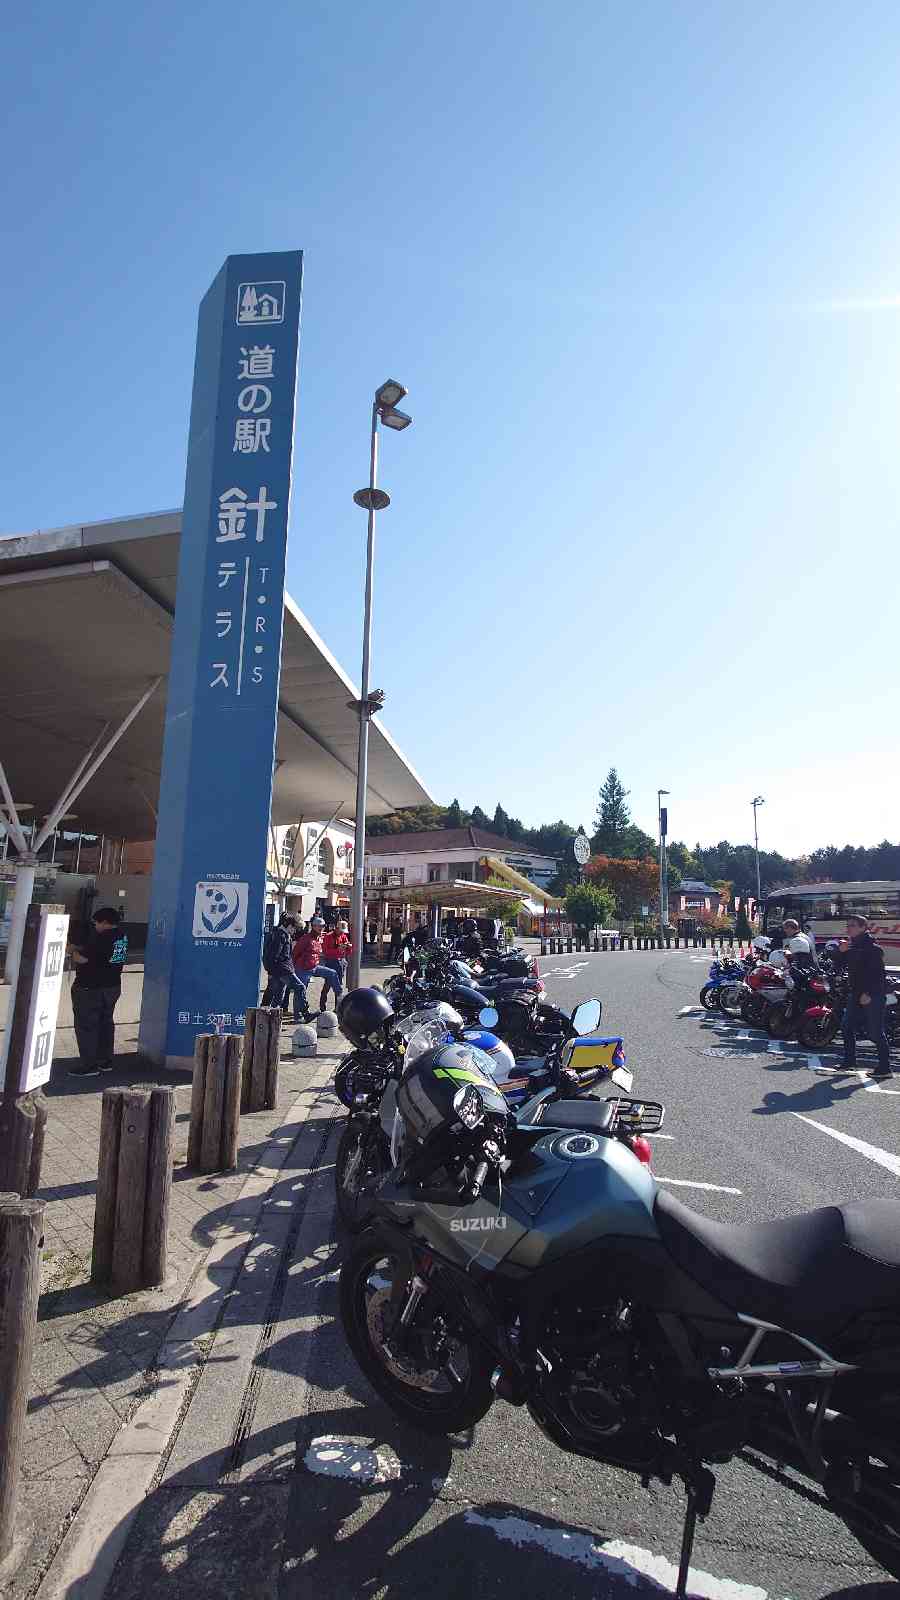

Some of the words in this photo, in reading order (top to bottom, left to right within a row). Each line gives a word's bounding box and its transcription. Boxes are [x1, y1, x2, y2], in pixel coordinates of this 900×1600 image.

[232, 345, 275, 454] 道の駅
[215, 485, 278, 543] 針
[208, 562, 237, 688] テラス
[178, 1011, 246, 1026] 国土交通省
[449, 1216, 507, 1232] SUZUKI
